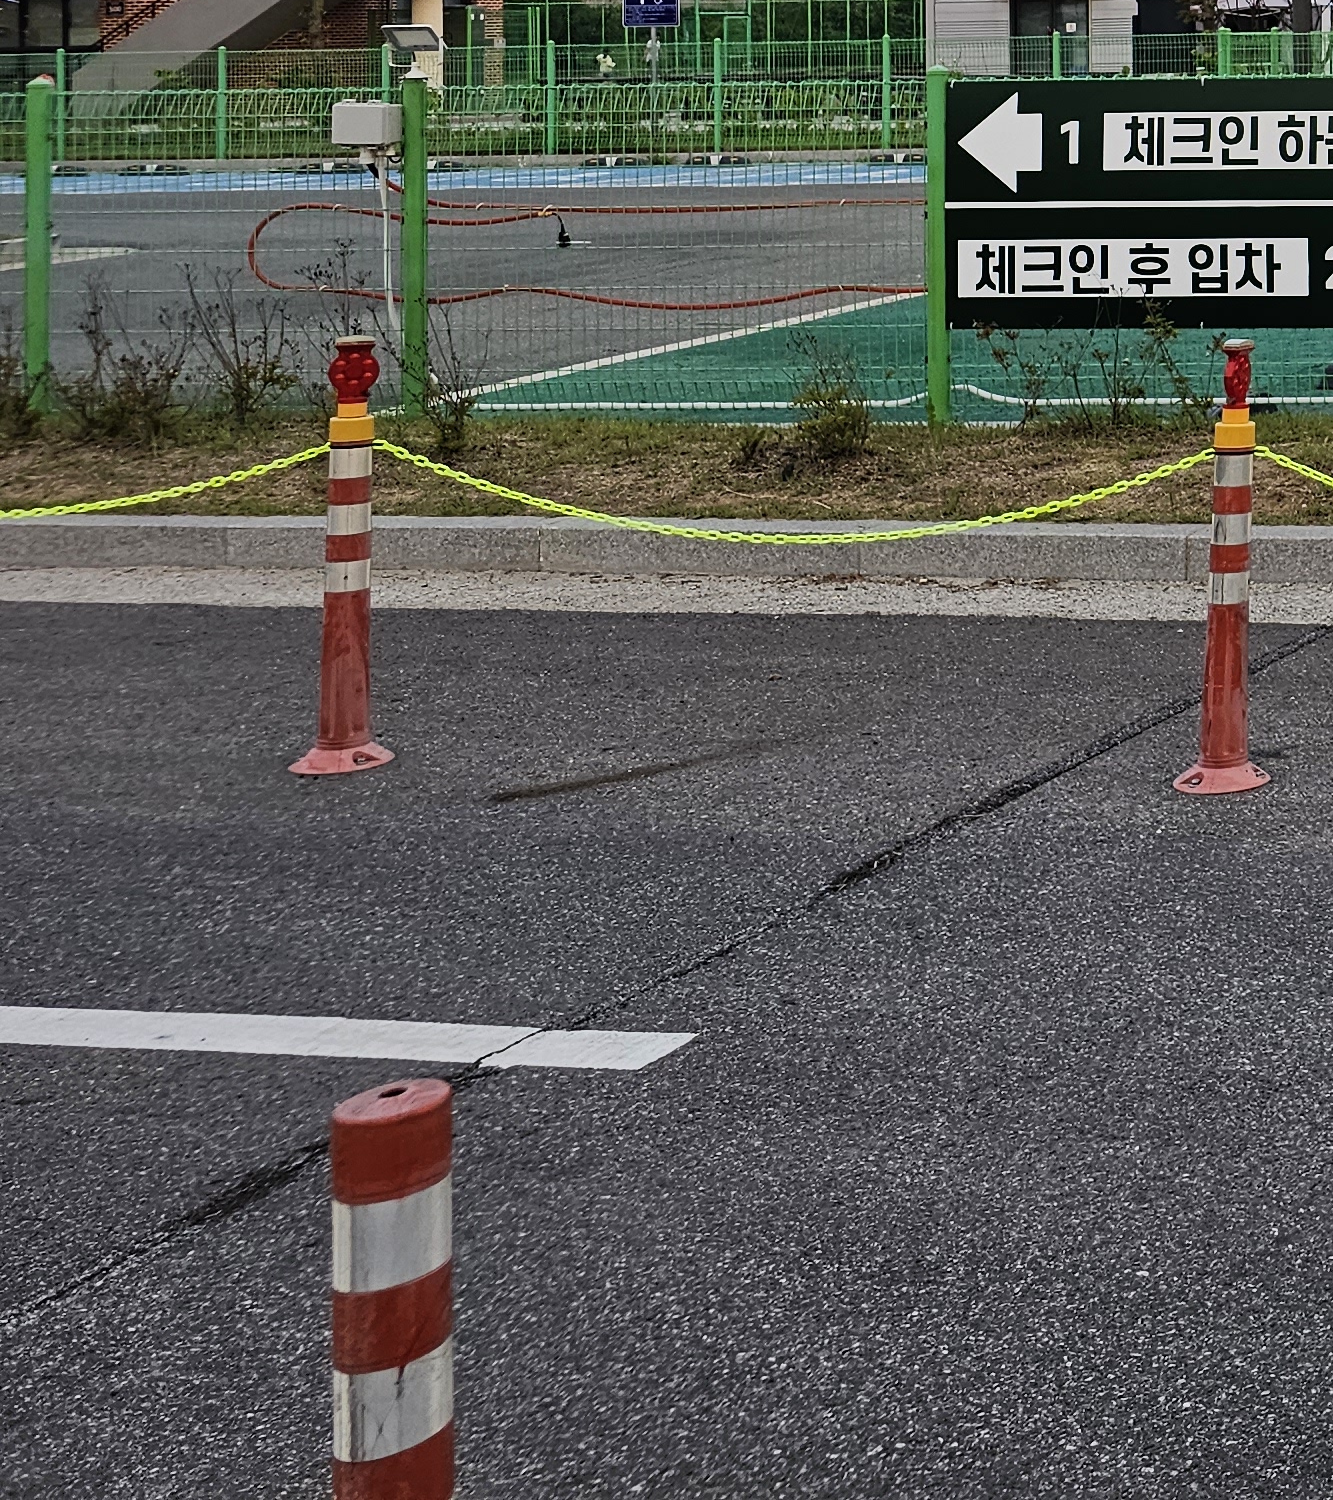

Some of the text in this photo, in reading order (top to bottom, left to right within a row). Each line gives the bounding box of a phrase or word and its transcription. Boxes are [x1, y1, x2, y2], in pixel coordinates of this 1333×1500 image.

[1059, 120, 1080, 165] 1
[1123, 115, 1260, 167] 체크인
[975, 243, 1109, 296] 체크인
[1127, 242, 1171, 294] 후
[1187, 242, 1282, 294] 입차
